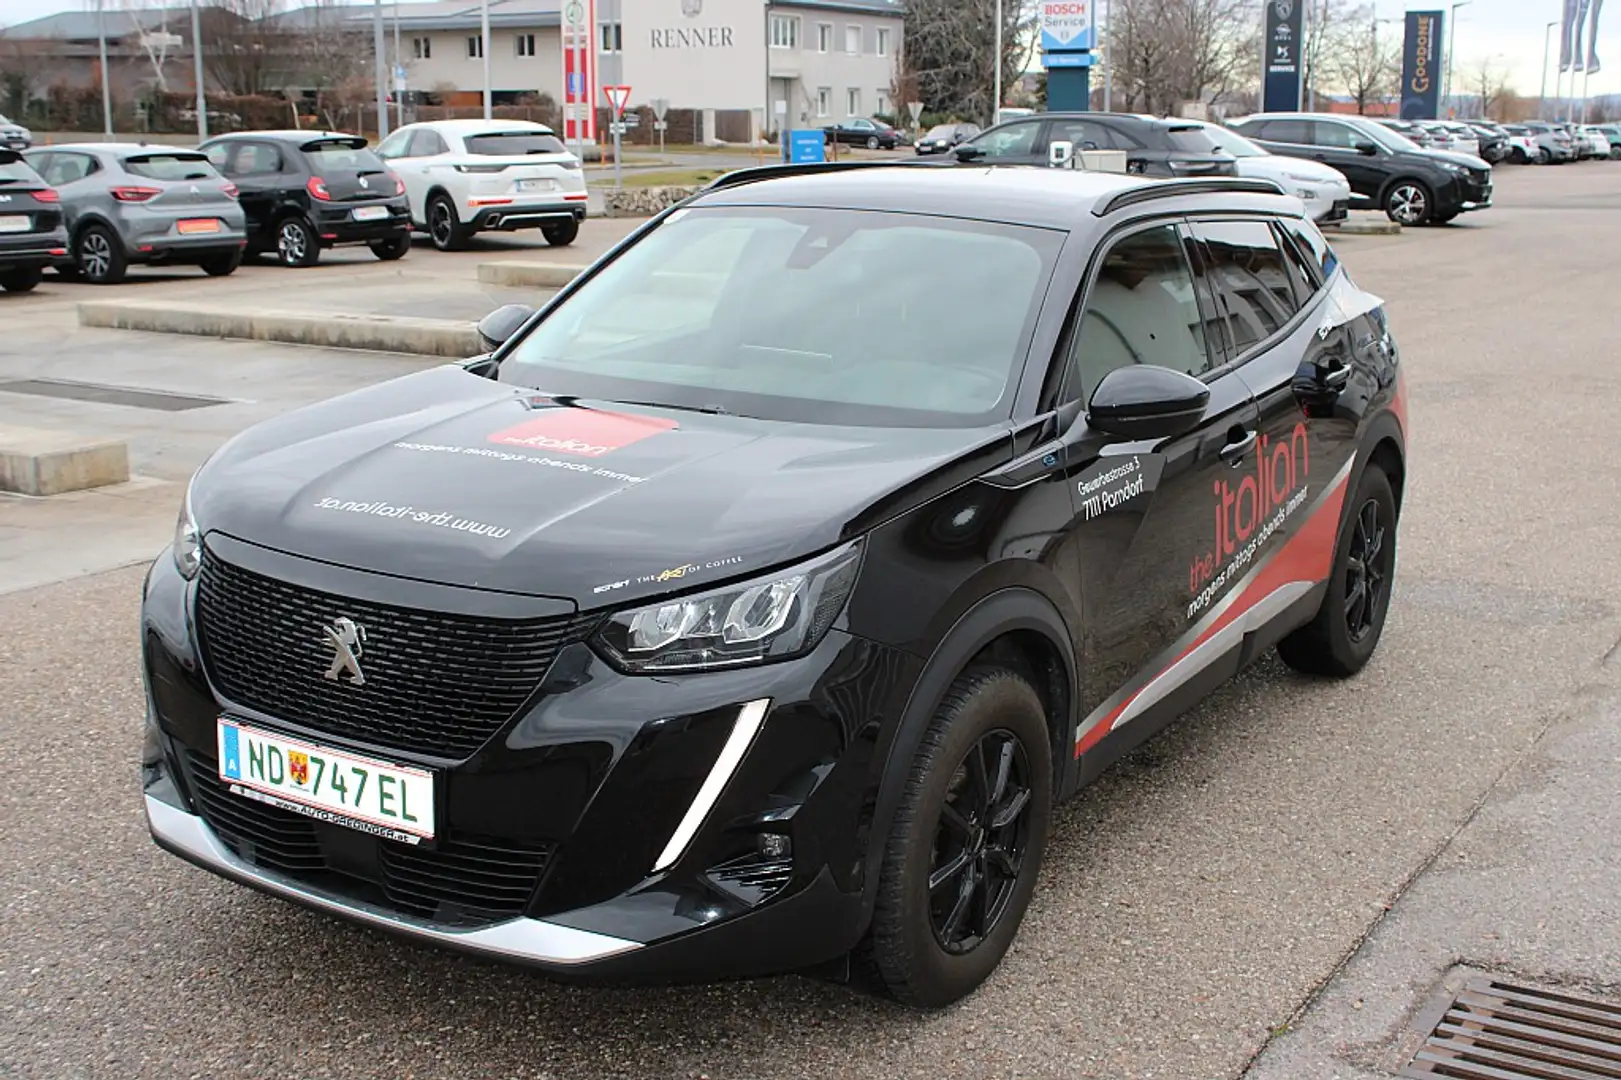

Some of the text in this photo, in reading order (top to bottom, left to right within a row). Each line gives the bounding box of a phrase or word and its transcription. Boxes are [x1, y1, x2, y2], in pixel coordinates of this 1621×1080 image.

[1045, 4, 1084, 15] BOSCH
[1045, 17, 1086, 27] Service
[650, 27, 733, 48] RENNER
[527, 457, 592, 472] abends
[593, 468, 647, 483] immer
[1133, 455, 1141, 469] 3
[1082, 473, 1144, 521] 7111 Parndorf
[1189, 422, 1309, 593] the italian
[1187, 484, 1309, 619] morgens mittags abends immer
[636, 574, 655, 584] THE
[706, 555, 743, 569] COFFEE
[227, 737, 418, 823] A ND 747 EL
